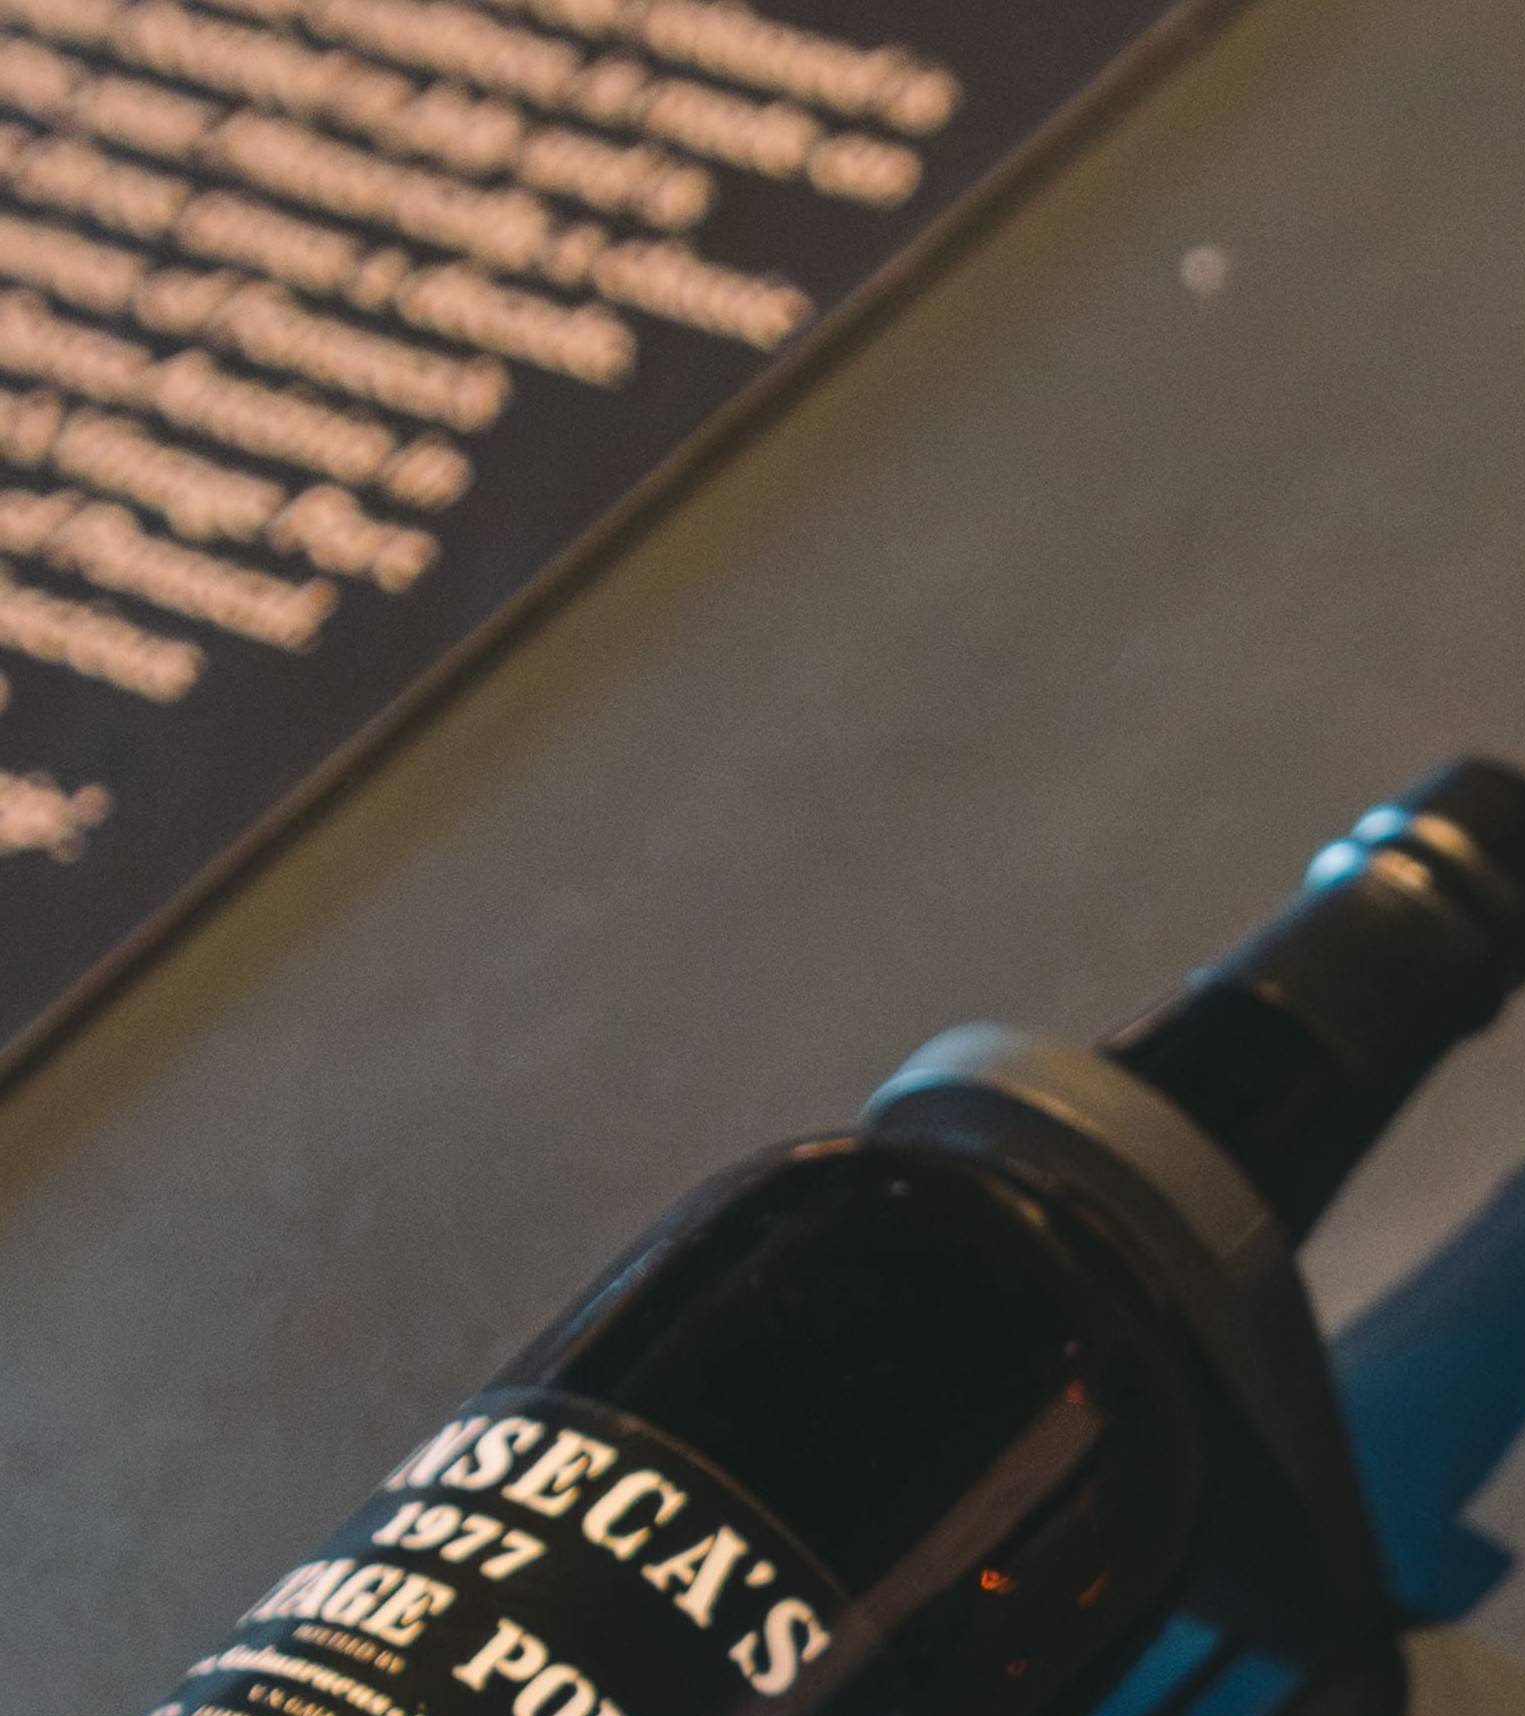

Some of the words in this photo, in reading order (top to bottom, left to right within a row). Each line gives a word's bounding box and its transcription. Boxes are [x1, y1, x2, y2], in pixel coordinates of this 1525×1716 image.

[371, 1502, 548, 1580] 1977
[383, 1415, 832, 1696] NSECA'S
[236, 1558, 457, 1647] TAGE
